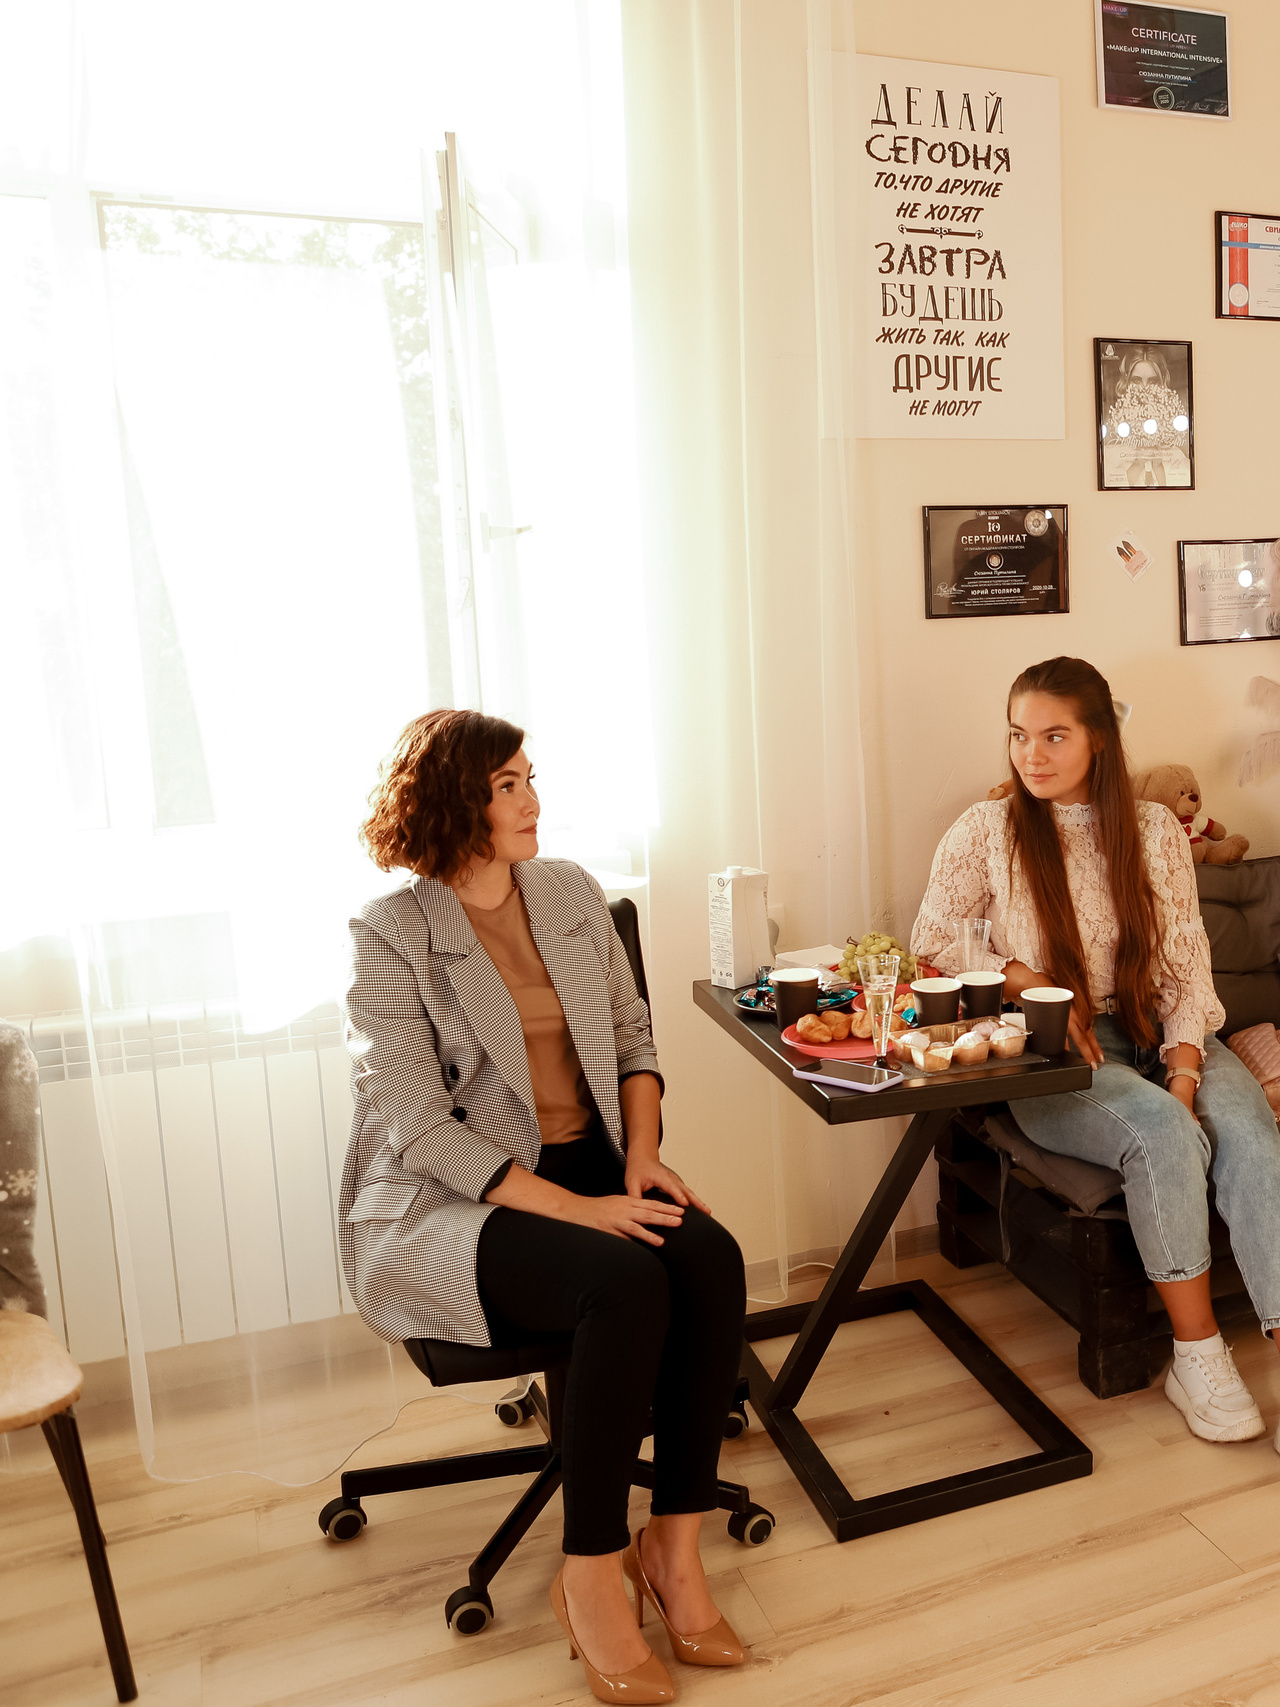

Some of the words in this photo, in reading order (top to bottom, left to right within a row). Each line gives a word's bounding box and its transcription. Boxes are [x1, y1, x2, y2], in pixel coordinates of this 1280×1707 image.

[1131, 27, 1198, 45] CERTIFICATE
[1140, 48, 1188, 60] INTERNATIONAL
[1138, 70, 1164, 78] СЮЗАННА
[871, 84, 1004, 134] ДЕЛАЙ
[865, 133, 1011, 174] СЕГОДНЯ
[935, 178, 1004, 198] ДРУГИЕ
[895, 201, 922, 218] НЕ
[924, 203, 984, 223] ХОТЯТ
[874, 242, 1007, 280] ЗАВТРА
[880, 282, 1004, 325] БУДЕШЬ
[875, 326, 926, 345] ЖИТЬ
[974, 331, 1011, 349] КАК
[892, 353, 1003, 393] ДРУГИЕ
[908, 399, 931, 416] НЕ
[932, 399, 983, 417] МОГУТ
[960, 533, 1028, 545] СЕРТИФИКАТ
[970, 588, 988, 596] ЮРИЙ
